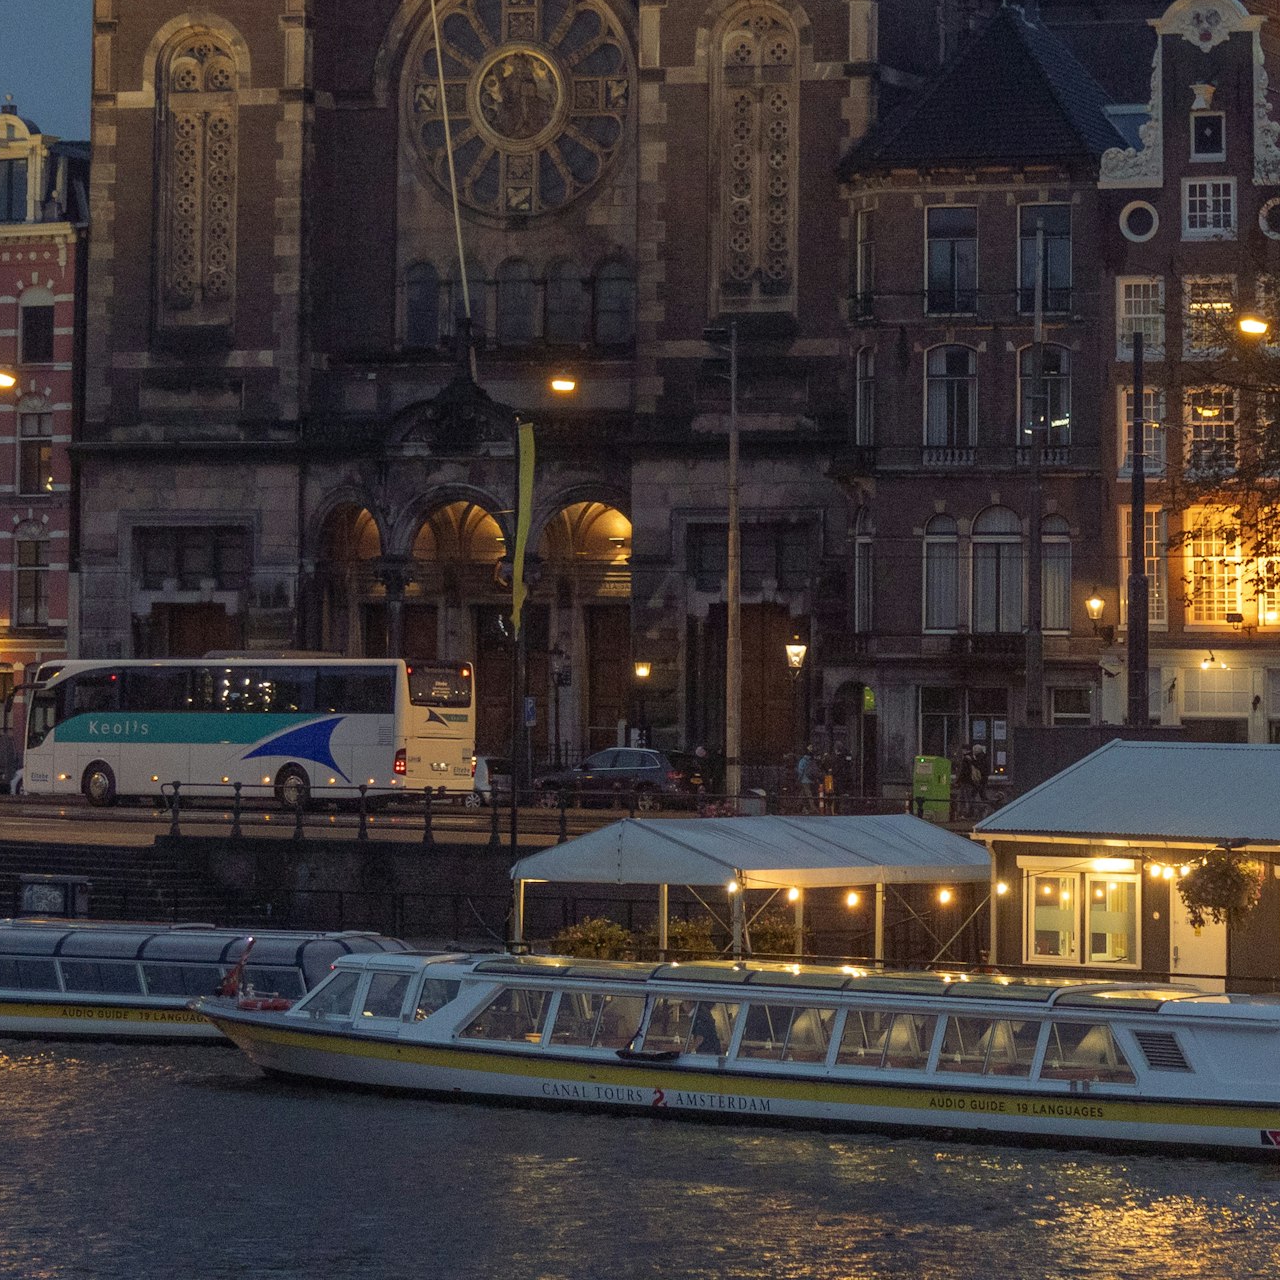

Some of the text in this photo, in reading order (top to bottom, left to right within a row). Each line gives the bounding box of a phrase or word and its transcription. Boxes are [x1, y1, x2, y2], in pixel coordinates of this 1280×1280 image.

[89, 720, 149, 736] Keolis
[61, 1008, 94, 1018] AUDIO
[97, 1009, 129, 1020] GUIDE
[139, 1011, 150, 1021] 19
[542, 1082, 771, 1112] CANAL TOURS AMSTERDAM
[929, 1097, 1104, 1118] AUDIO GUIDE 19 LANGUAGES
